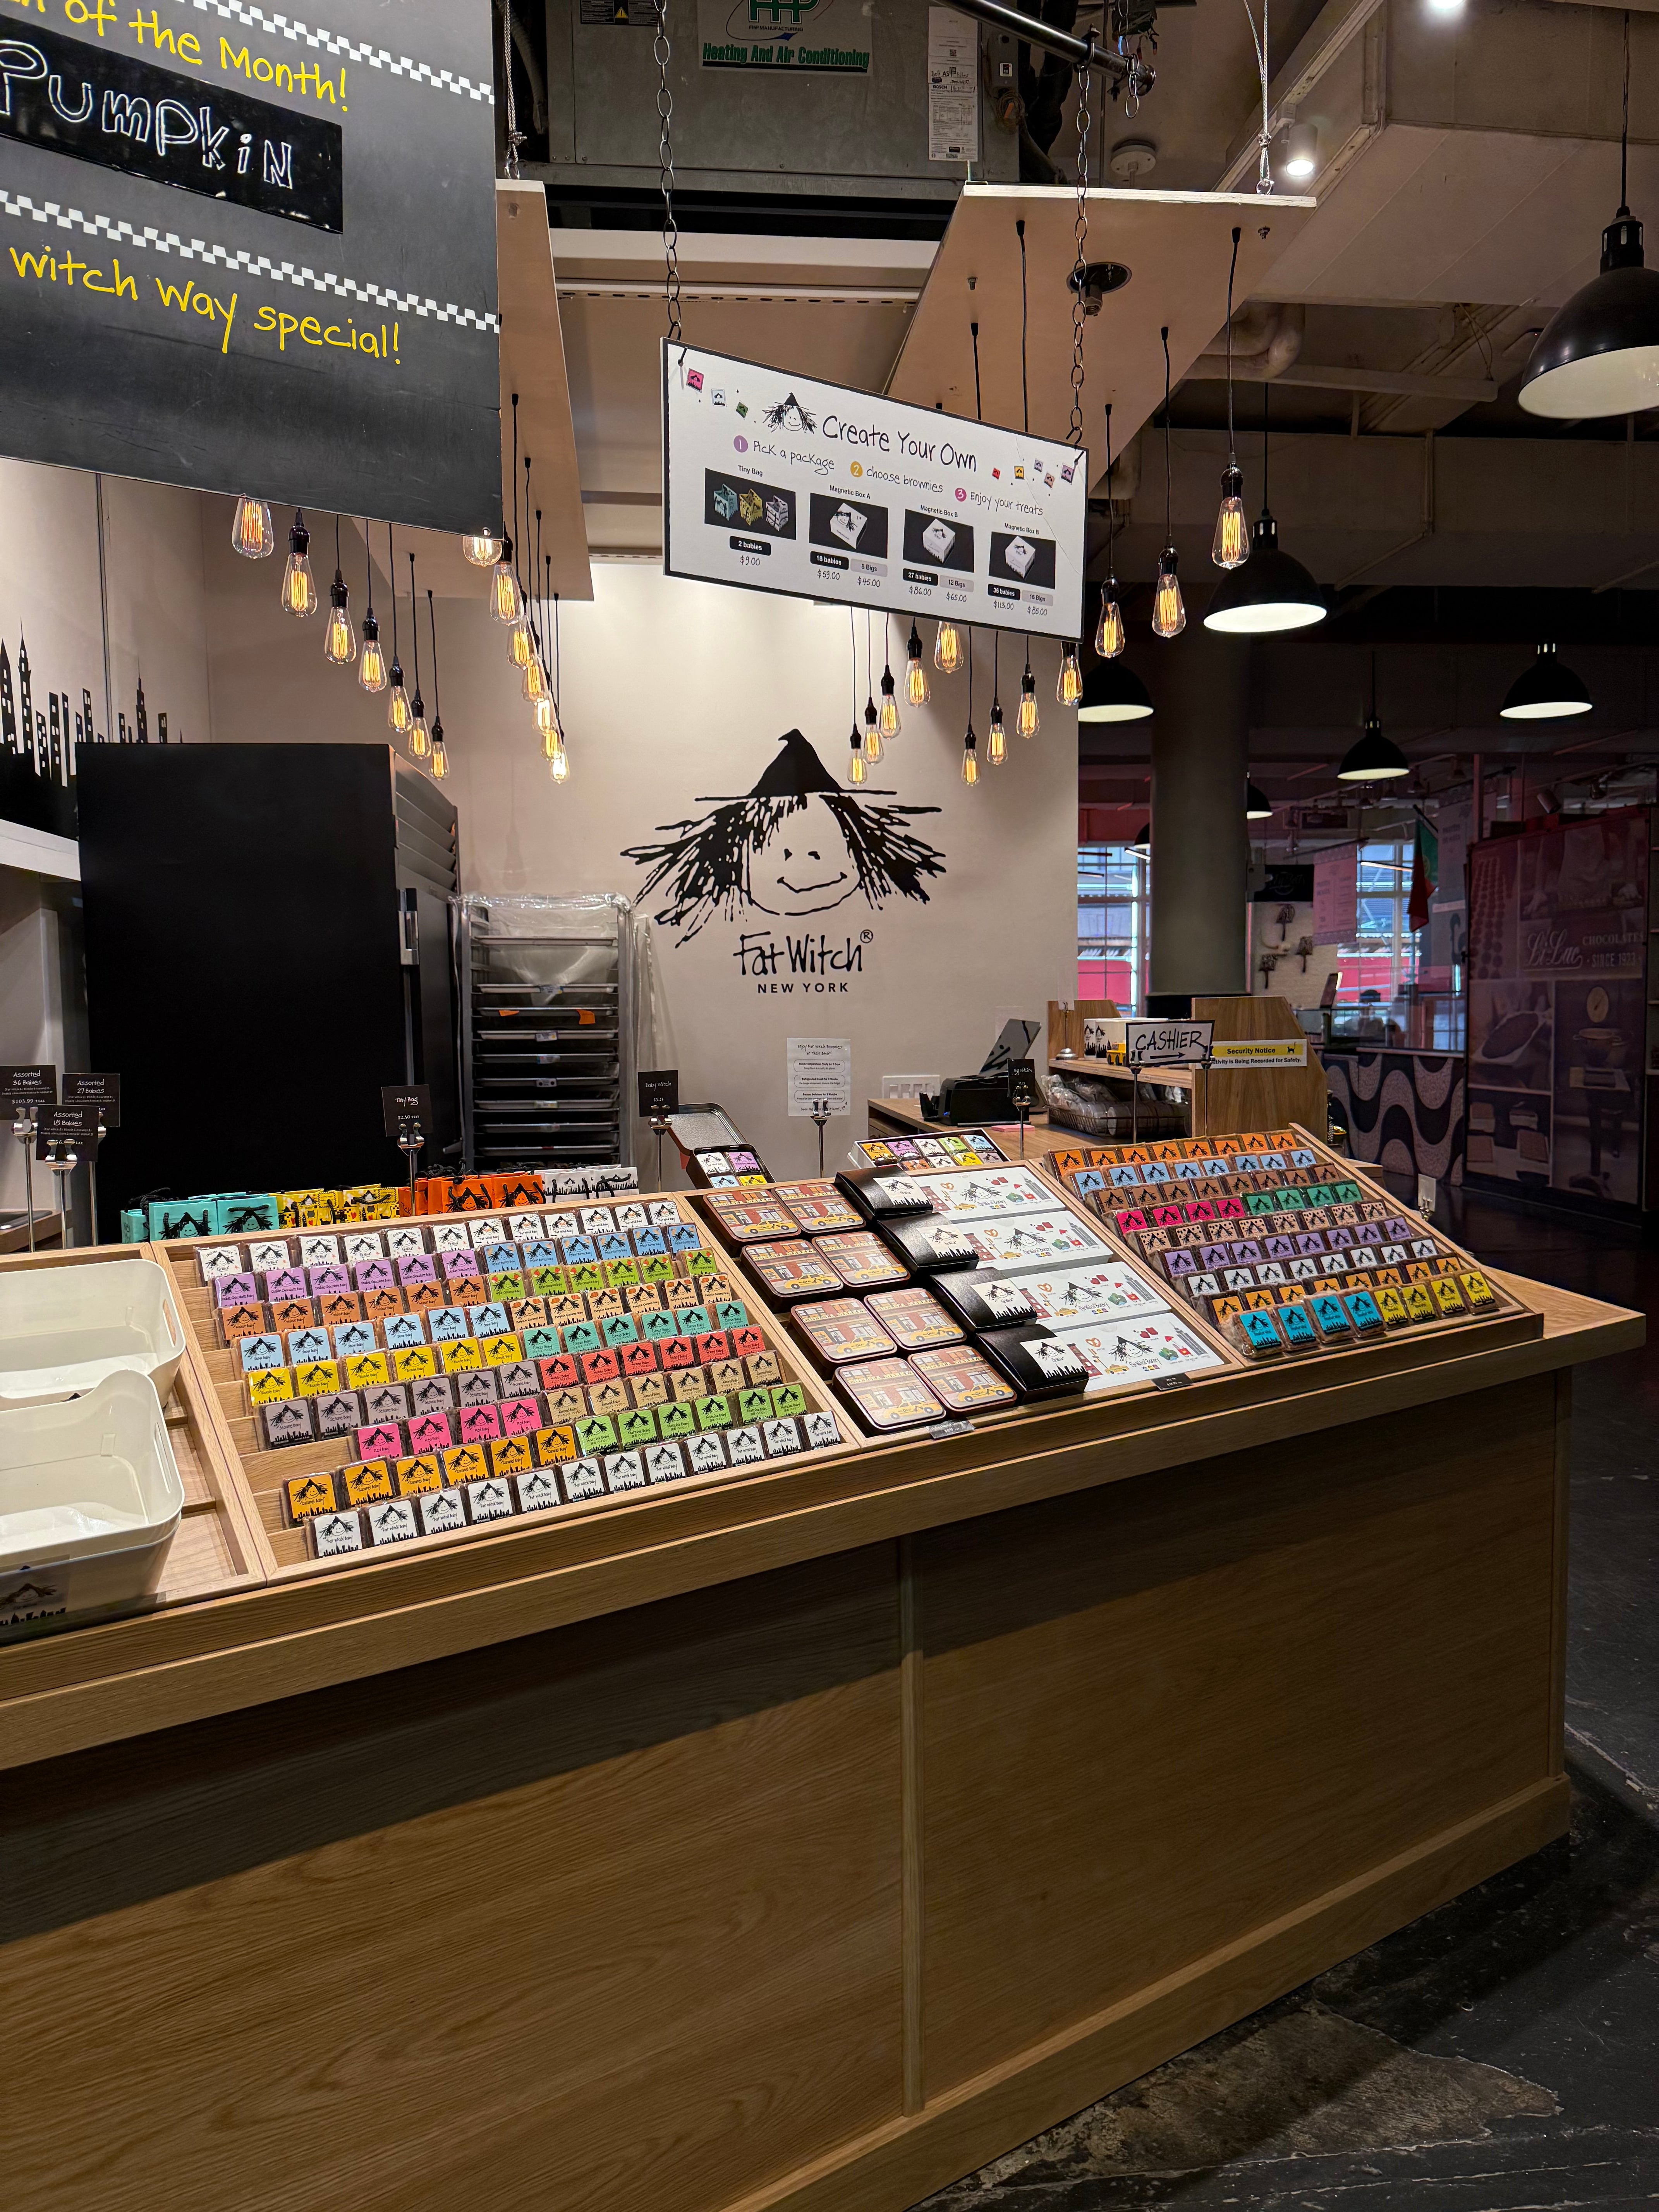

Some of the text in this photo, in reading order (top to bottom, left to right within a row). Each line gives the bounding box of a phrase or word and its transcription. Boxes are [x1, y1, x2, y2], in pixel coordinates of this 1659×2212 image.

[65, 0, 349, 112] of the Month!
[703, 43, 870, 69] Heating And Air Conditioning
[253, 306, 402, 365] special!
[822, 415, 977, 473] Create Your Own
[780, 450, 786, 459] a
[738, 465, 763, 477] Tiny Bag
[853, 464, 943, 493] 2 choose brownies
[830, 484, 854, 495] Magnetic
[957, 489, 1043, 516] 3 Enjoy your treats
[920, 505, 943, 515] Magnetic
[1005, 523, 1025, 533] Magnetic
[743, 541, 762, 551] babies
[740, 555, 760, 566] $9.00
[824, 556, 842, 565] babies
[866, 564, 877, 573] Bigs
[817, 569, 840, 580] $59.00
[915, 573, 931, 582] babies
[857, 577, 880, 587] $45.00
[909, 586, 931, 596] $86.00
[1000, 588, 1015, 597] babies
[946, 592, 967, 603] $65.00
[993, 600, 1014, 610] $113.00
[1027, 606, 1047, 616] $85.00
[1582, 933, 1644, 945] CHOCOLATES
[733, 931, 784, 976] Fat
[1592, 952, 1636, 967] SINCE 1923
[757, 982, 849, 994] NEW YORK
[1135, 1028, 1204, 1050] CASHIER
[1227, 1047, 1253, 1055] Security
[645, 1082, 657, 1091] Baby
[395, 1097, 419, 1107] Tiny Bag
